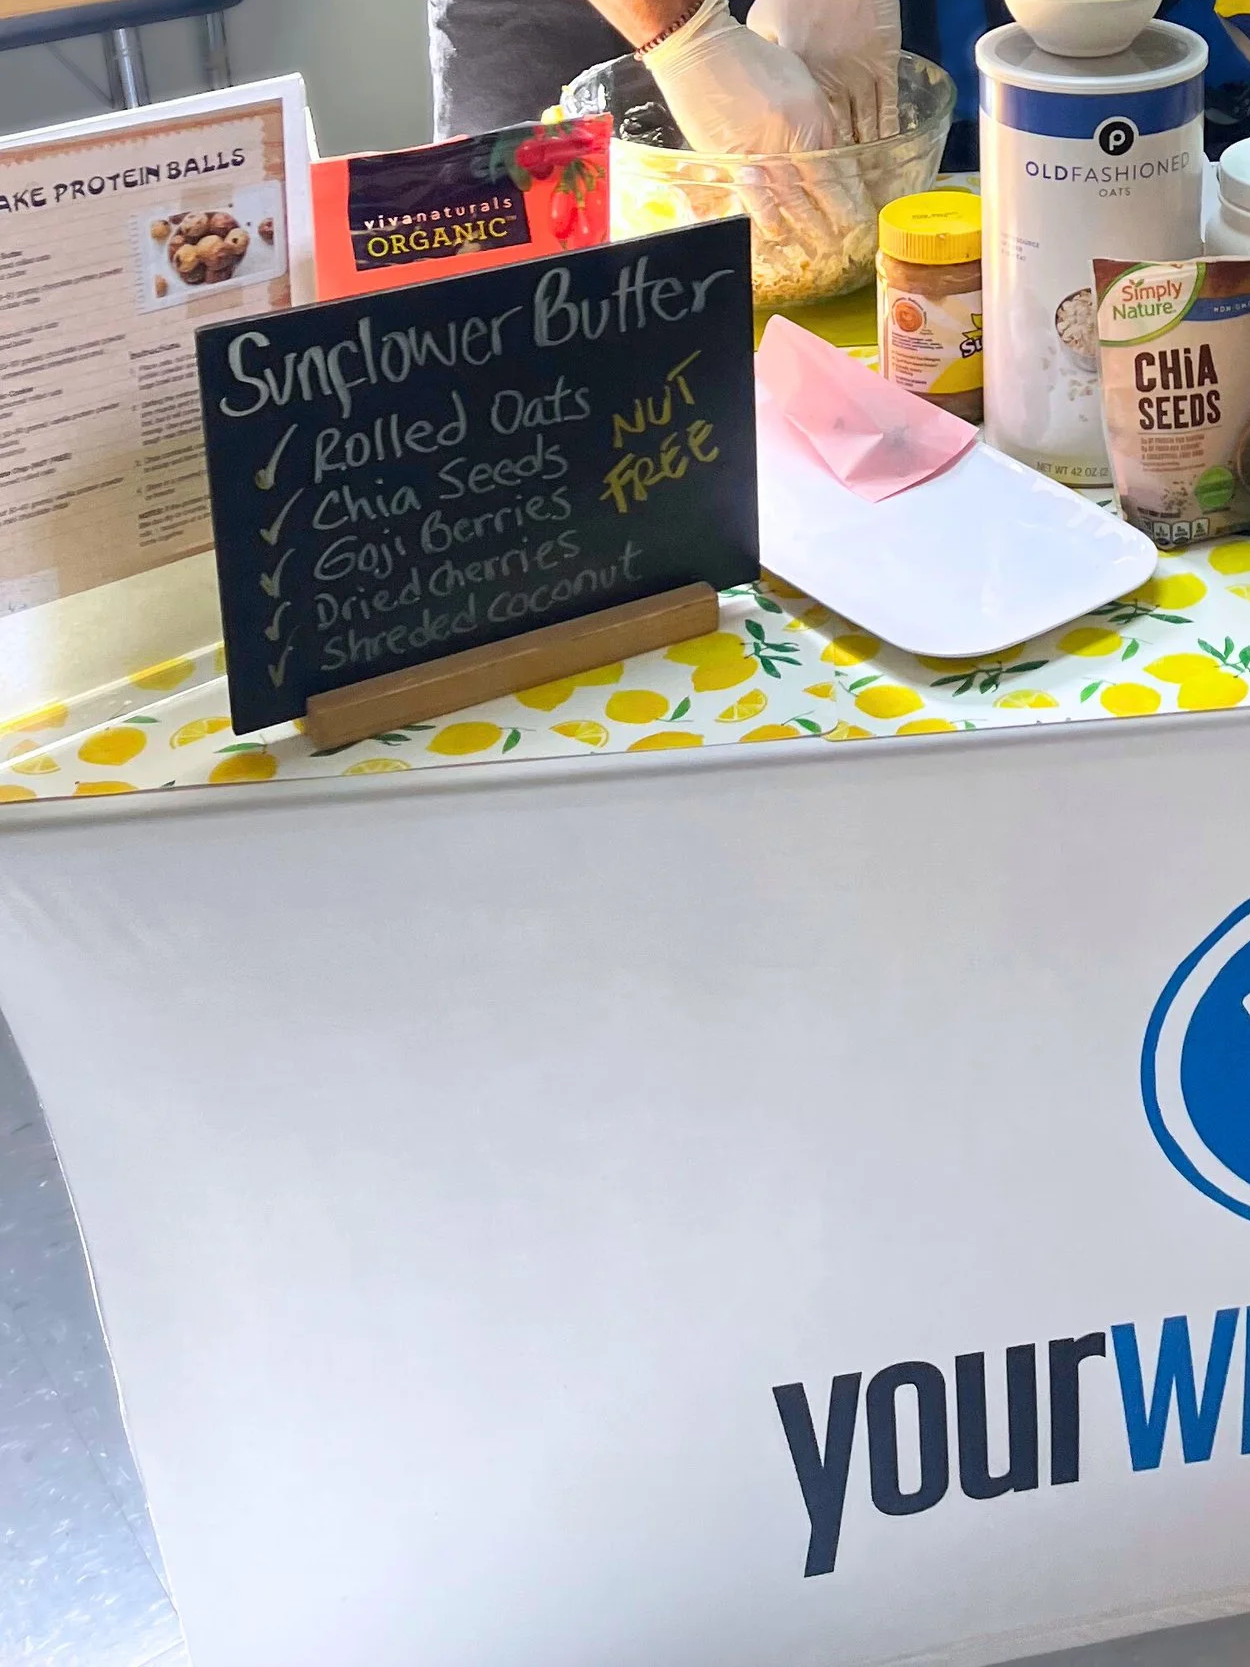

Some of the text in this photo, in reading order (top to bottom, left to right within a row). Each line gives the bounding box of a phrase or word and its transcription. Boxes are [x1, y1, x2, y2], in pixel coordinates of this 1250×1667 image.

[54, 165, 161, 203] PROTEIN
[167, 148, 246, 180] BALLS
[1099, 187, 1131, 197] OATS
[367, 217, 508, 258] ORGANIC
[1113, 301, 1174, 320] Nature
[1122, 280, 1183, 304] Simply
[220, 305, 523, 418] Sunflower
[535, 255, 734, 348] Butter
[612, 351, 702, 448] NUT
[1138, 390, 1221, 430] SEEDS
[314, 375, 591, 483] Rolled Oats
[312, 435, 569, 532] Chia Seeds
[599, 419, 720, 514] FREE
[1036, 461, 1052, 473] NET
[1055, 465, 1068, 475] WT
[1071, 466, 1082, 477] 42
[1085, 467, 1097, 477] OZ
[421, 486, 572, 555] Berries
[317, 570, 422, 630] Dried
